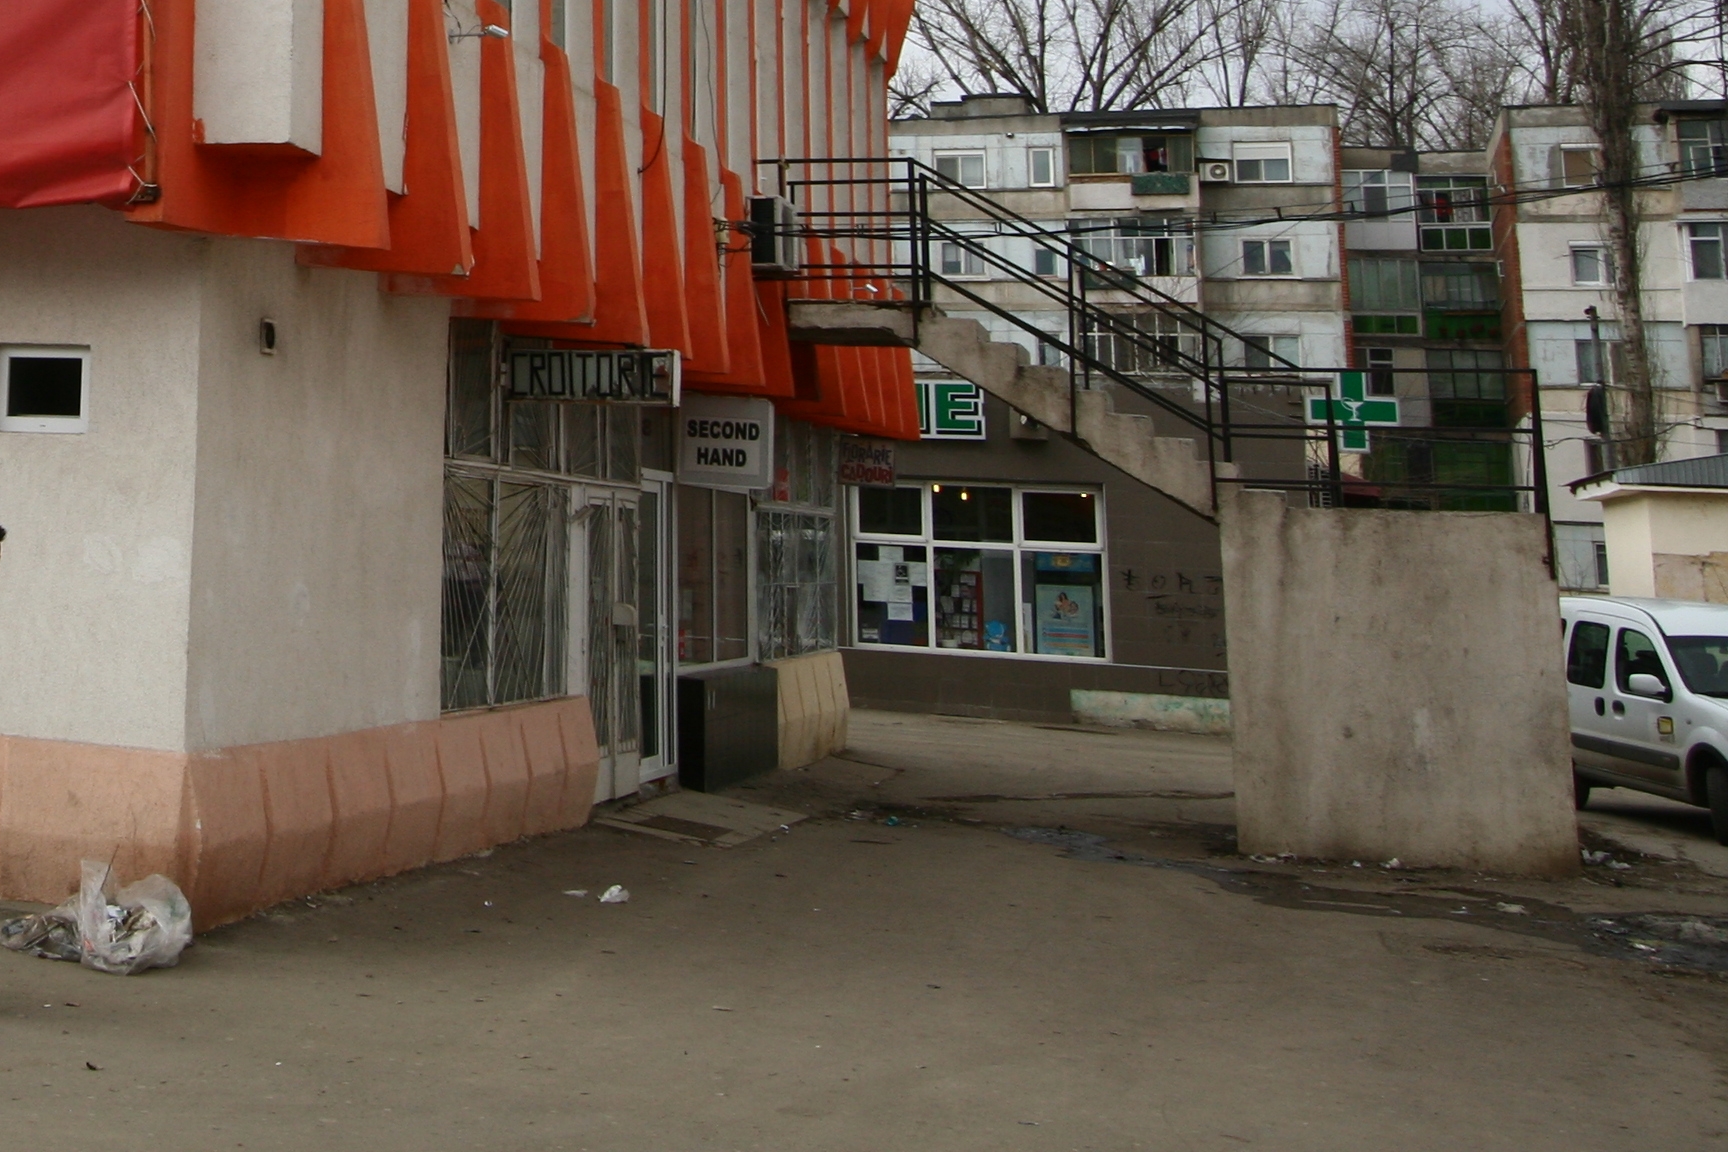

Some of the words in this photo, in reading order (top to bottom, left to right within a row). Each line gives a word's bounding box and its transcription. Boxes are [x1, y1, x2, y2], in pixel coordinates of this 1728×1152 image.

[511, 352, 669, 397] CROITORIE
[687, 419, 760, 441] SECOND
[697, 447, 747, 467] HAND
[841, 463, 893, 484] CADOURI
